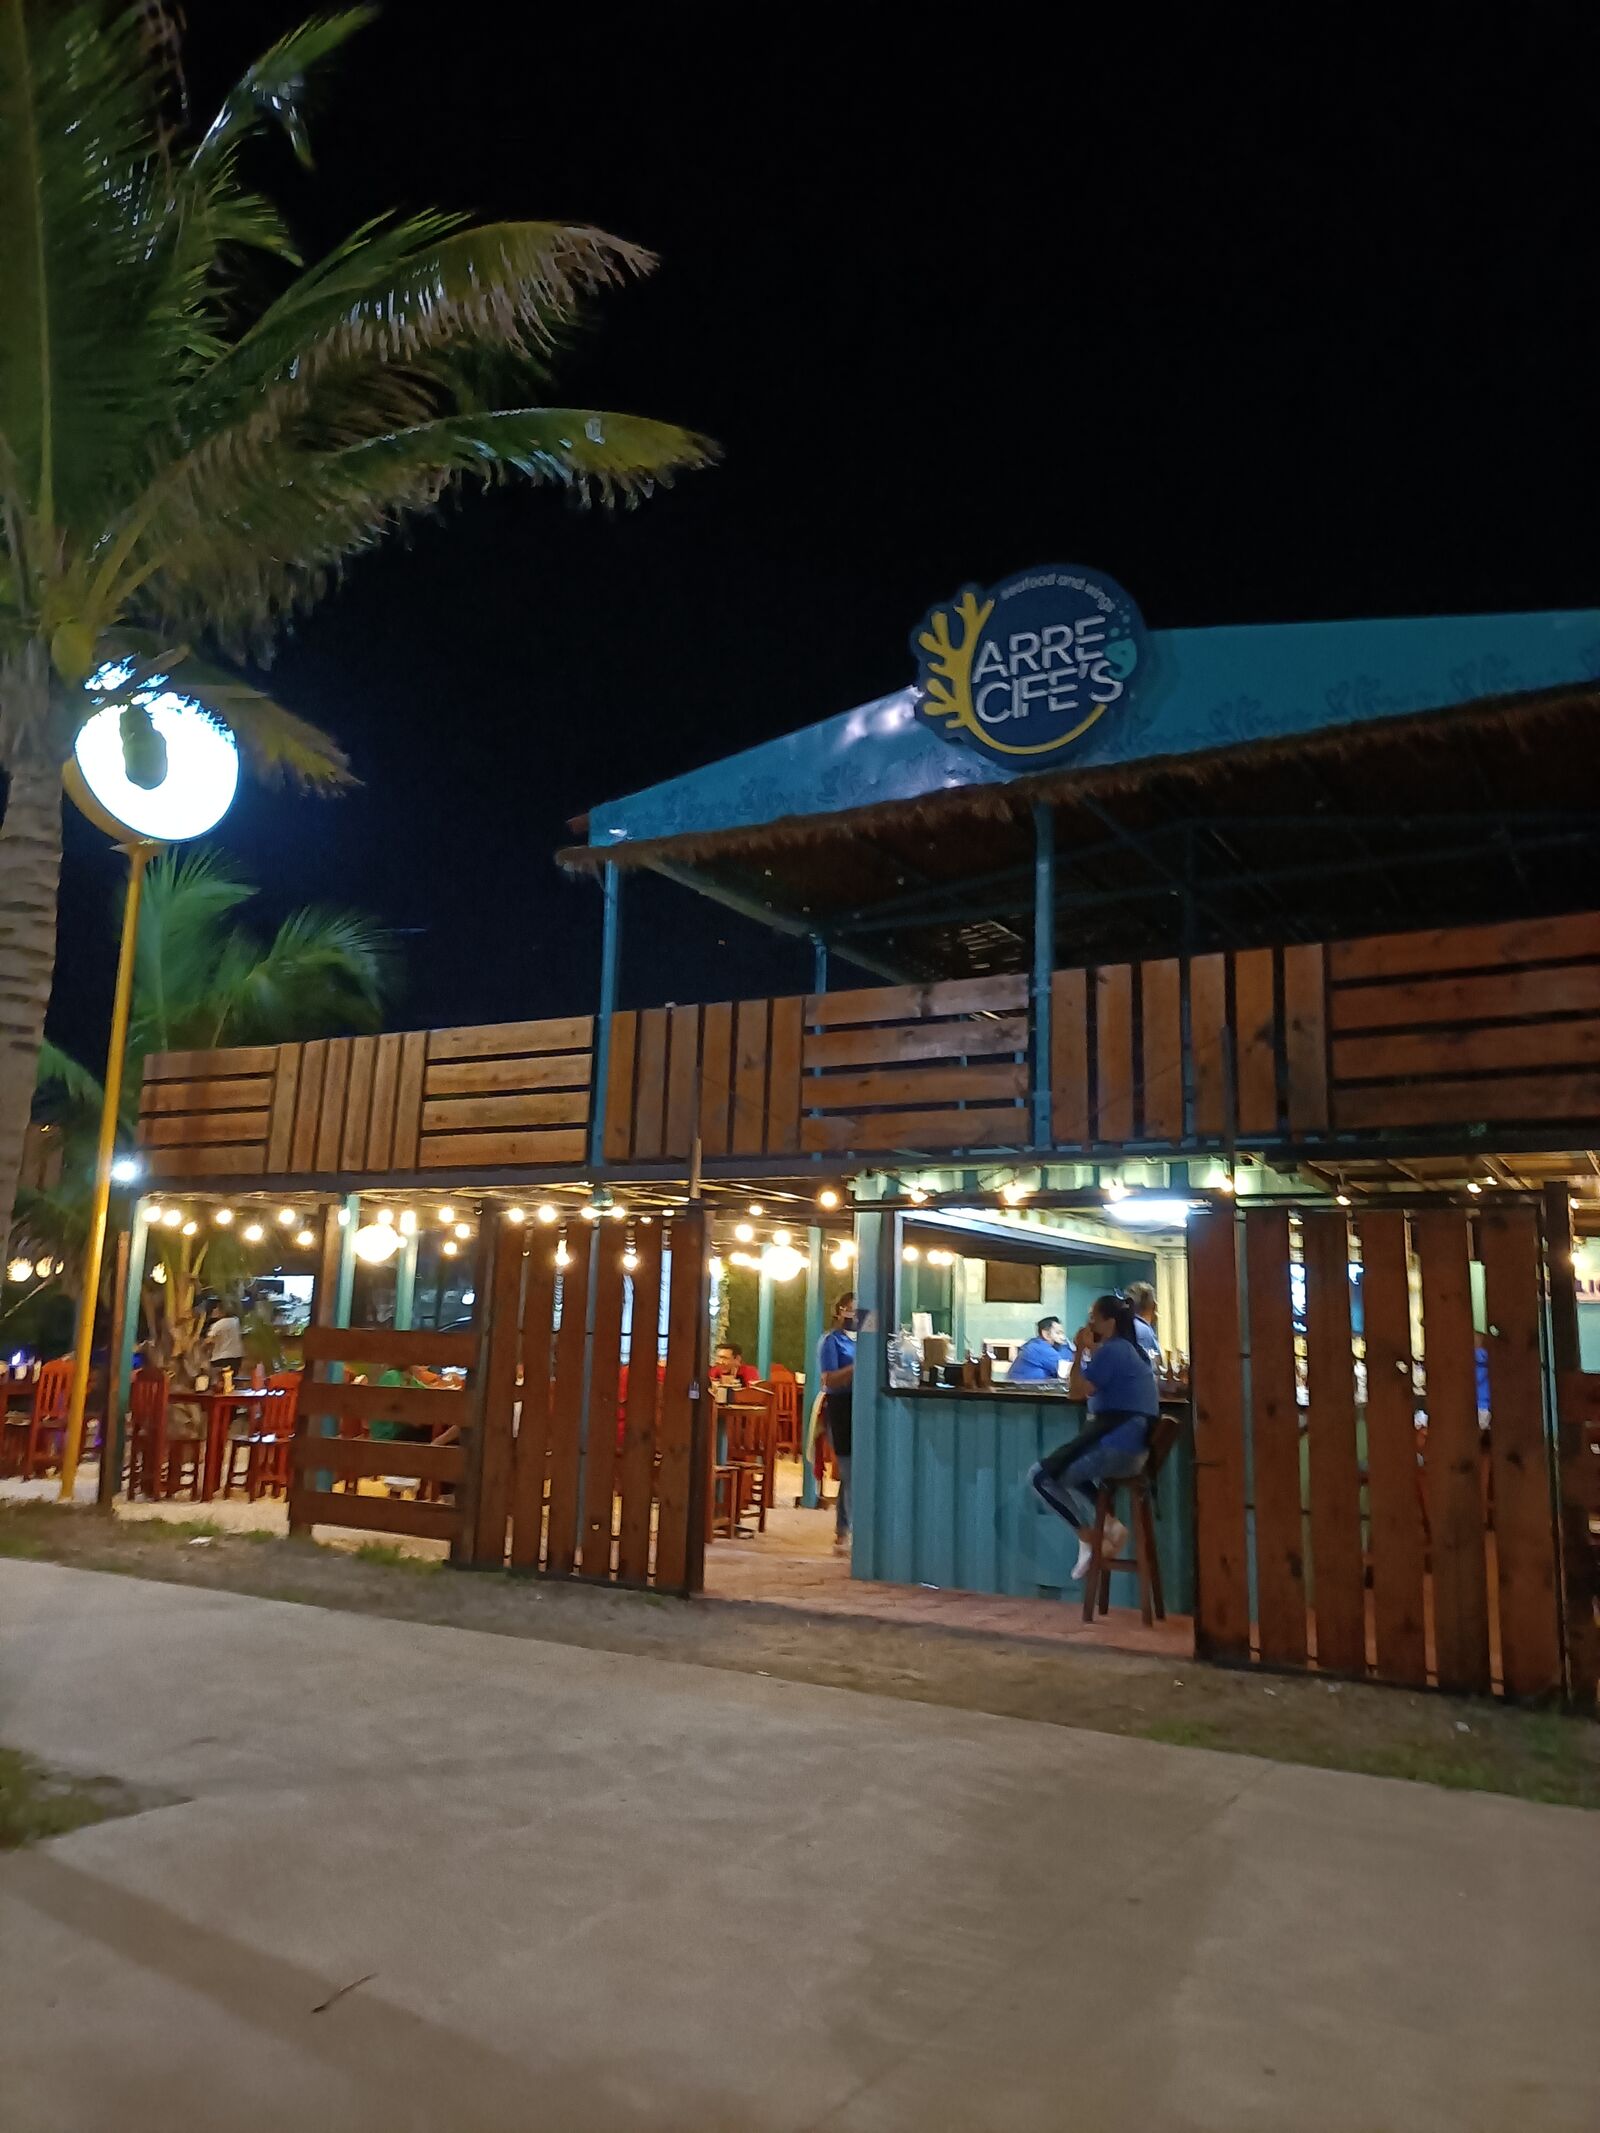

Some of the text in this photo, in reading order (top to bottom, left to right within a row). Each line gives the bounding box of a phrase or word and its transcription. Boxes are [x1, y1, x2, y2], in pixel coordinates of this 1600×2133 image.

[1001, 573, 1056, 600] seafood
[1056, 575, 1086, 590] and
[971, 615, 1106, 684] ARRE
